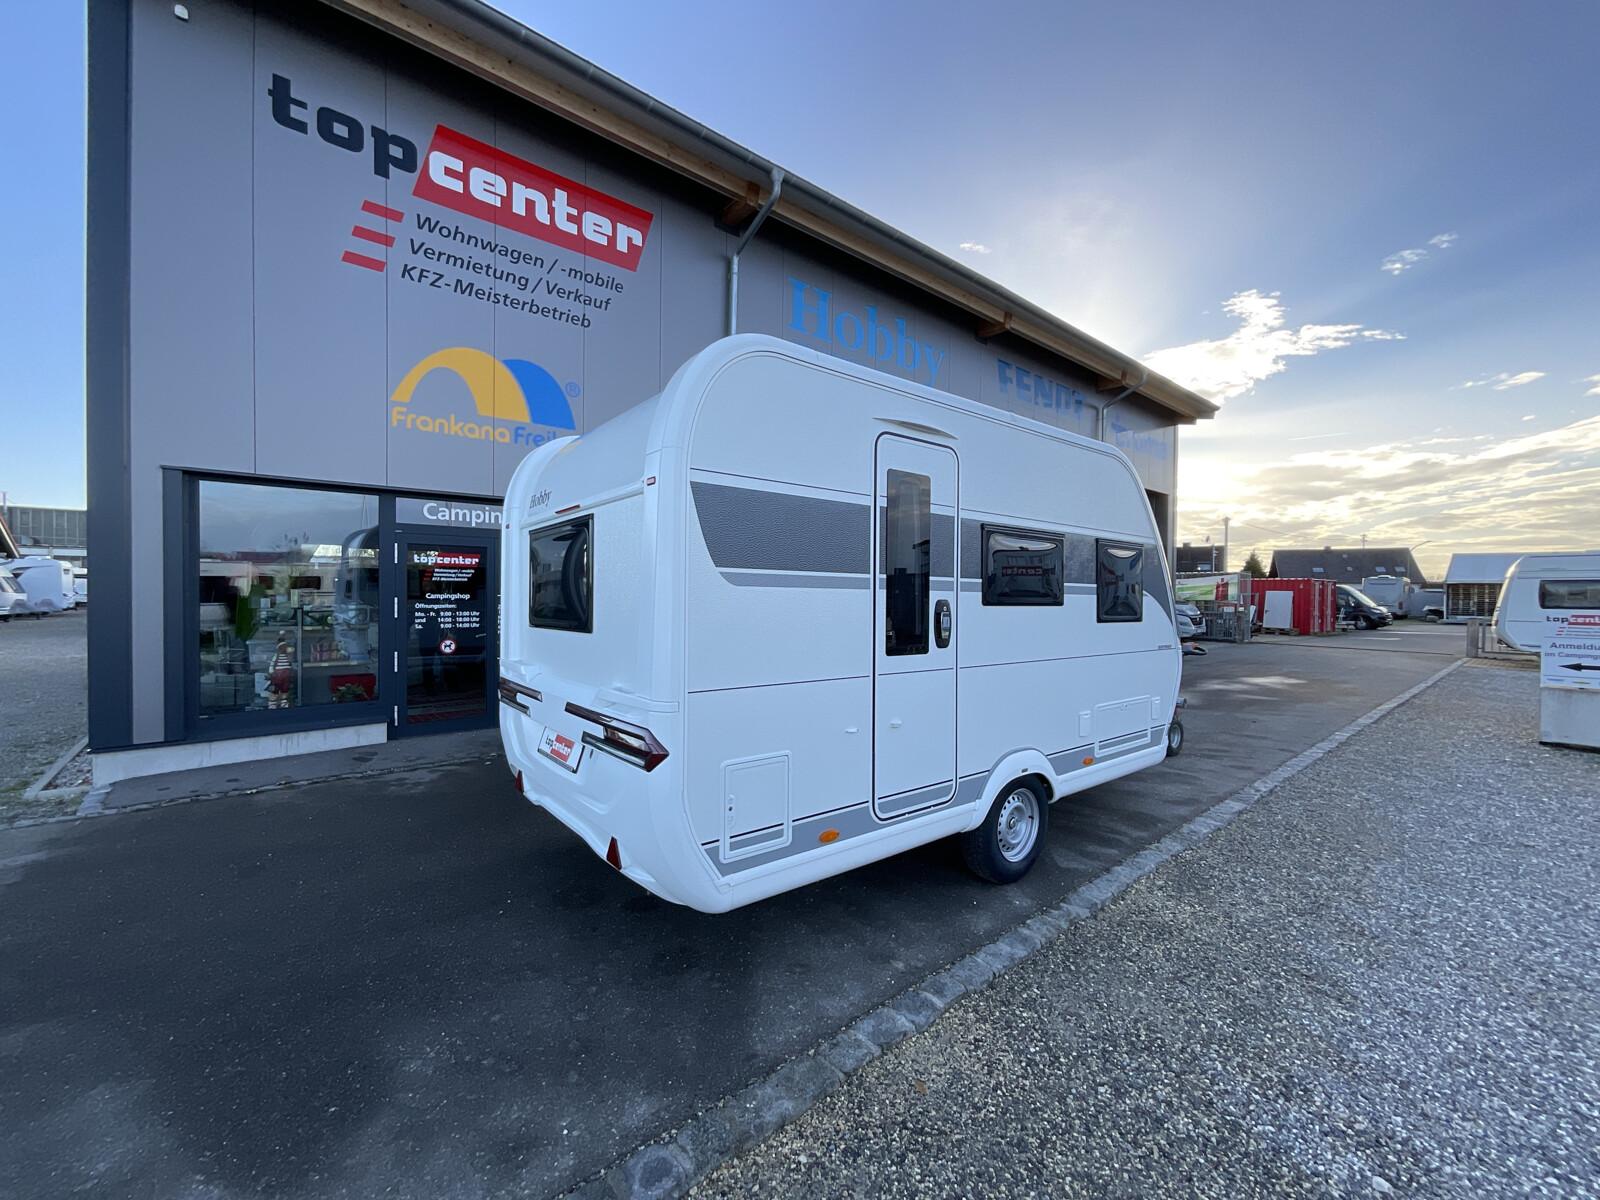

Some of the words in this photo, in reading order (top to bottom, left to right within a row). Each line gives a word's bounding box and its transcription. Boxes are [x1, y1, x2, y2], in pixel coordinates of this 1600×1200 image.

[416, 213, 545, 268] Wohnwagen
[401, 264, 591, 328] KFZ-Meisterbetrieb
[410, 238, 530, 290] Vermietung
[545, 279, 612, 311] Verkauf
[786, 275, 945, 386] Hobby
[529, 489, 552, 509] Hobby
[413, 553, 479, 565] topcenter
